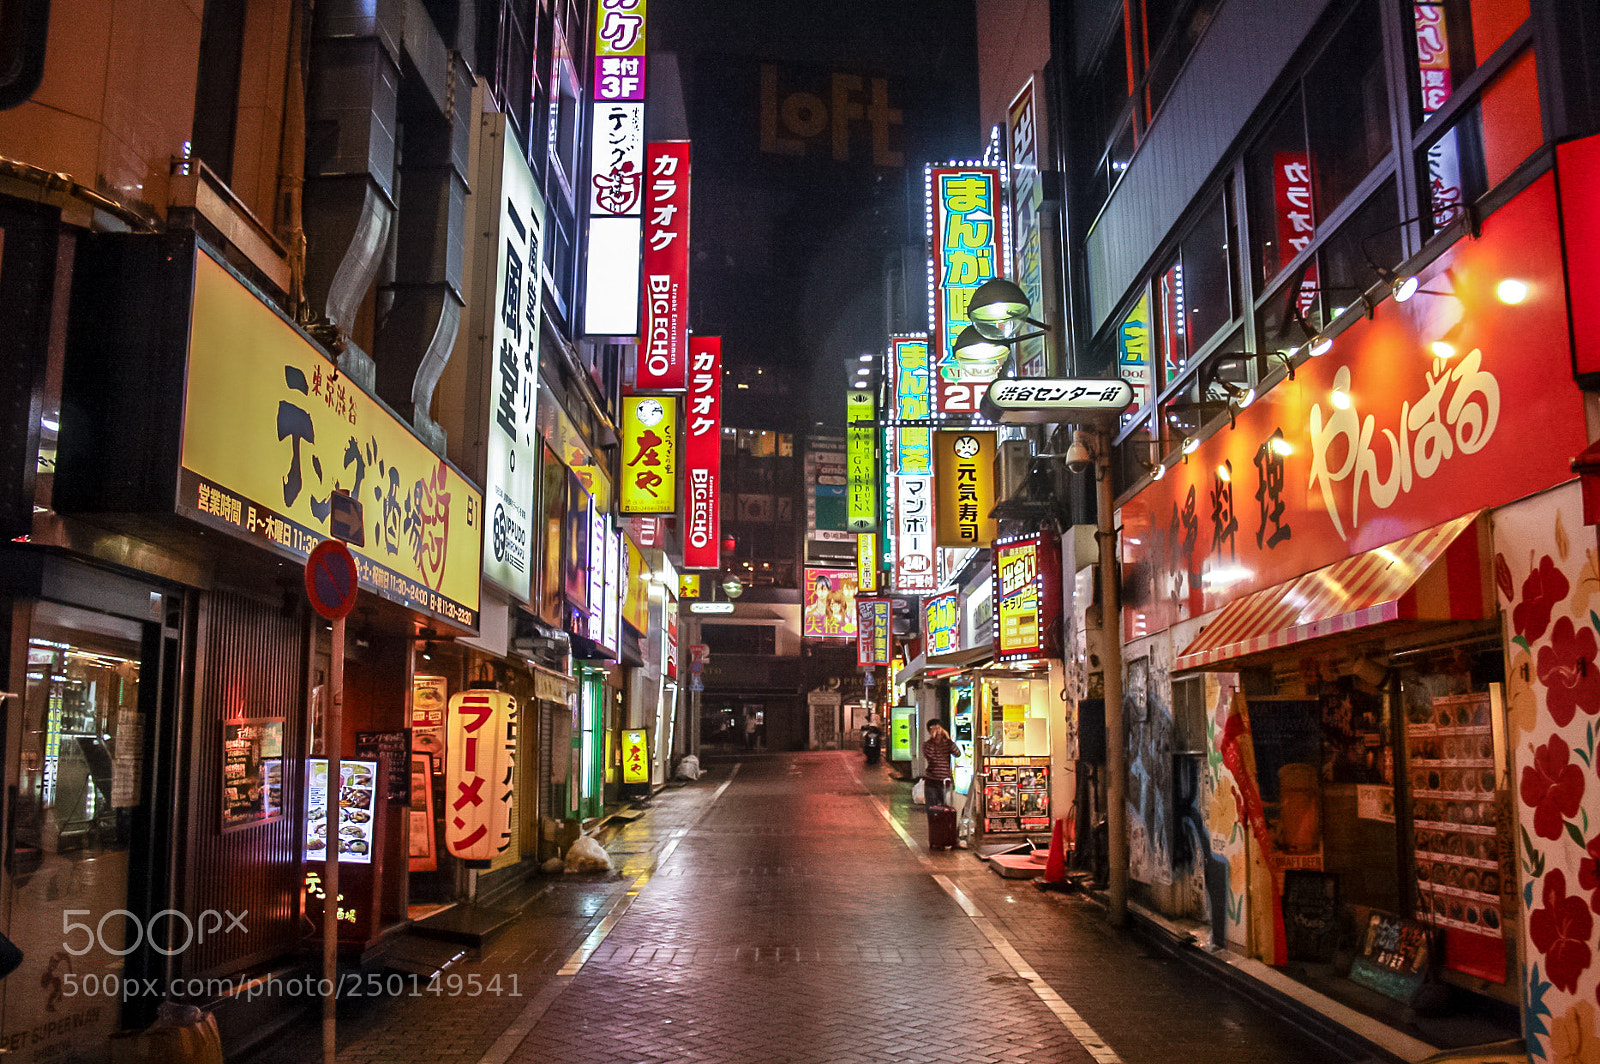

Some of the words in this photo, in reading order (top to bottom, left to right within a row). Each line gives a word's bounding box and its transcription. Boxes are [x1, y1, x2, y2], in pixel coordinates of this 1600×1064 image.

[601, 58, 638, 76] 受付
[601, 78, 638, 98] 3F
[650, 154, 678, 251] カラオケ
[650, 275, 670, 317] BIG
[648, 318, 670, 376] ECHO
[311, 364, 358, 426] 東京渋谷
[691, 352, 715, 436] カラオケ
[997, 386, 1122, 401] 渋谷センター街
[627, 430, 662, 498] 庄や
[1309, 348, 1500, 542] やんばる
[197, 483, 242, 526] 営業時間
[692, 469, 709, 500] BIG
[853, 456, 863, 511] GARDEN
[957, 463, 979, 542] 元気寿司
[467, 495, 478, 531] B1
[505, 514, 526, 547] IPPUDO
[691, 501, 708, 548] ECHO
[905, 481, 925, 550] マンボー
[1003, 553, 1037, 597] 出会い
[806, 616, 839, 634] 失格
[1003, 596, 1022, 611] キラリ
[452, 696, 493, 852] ラーメン
[626, 744, 642, 776] 庄や
